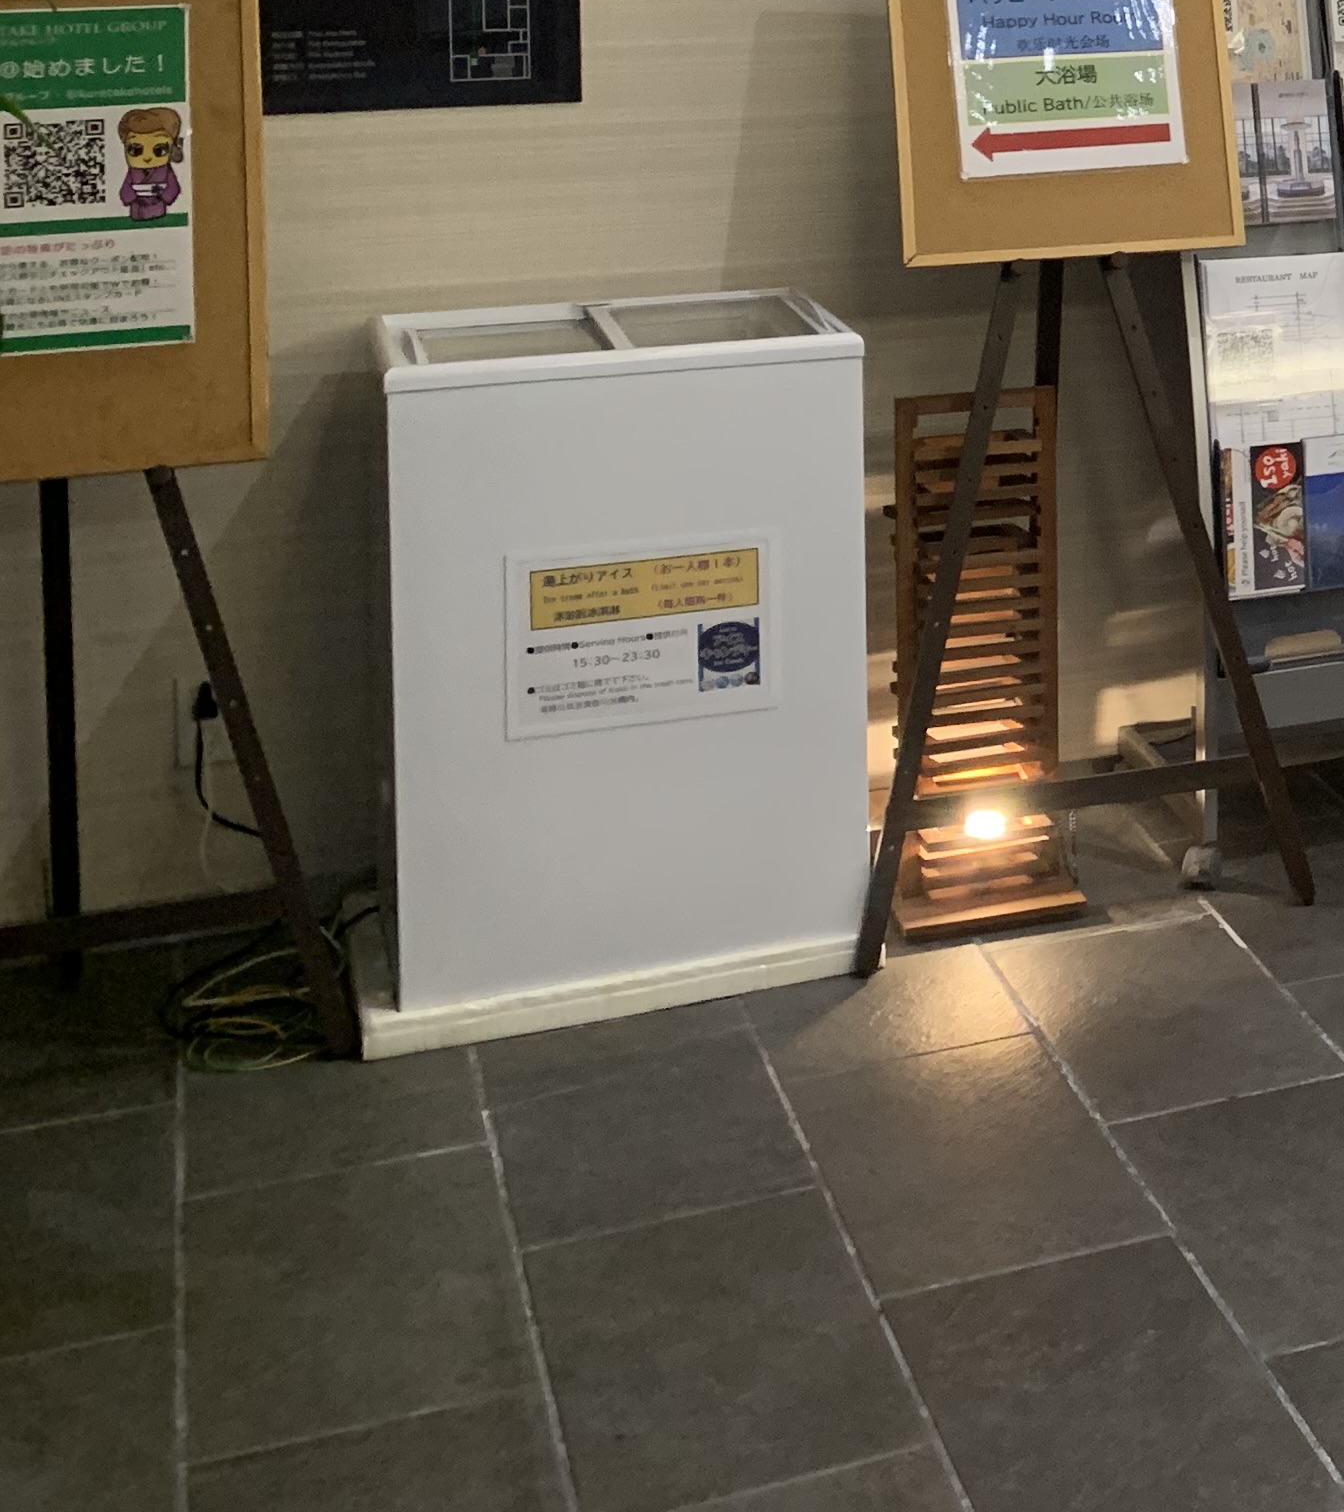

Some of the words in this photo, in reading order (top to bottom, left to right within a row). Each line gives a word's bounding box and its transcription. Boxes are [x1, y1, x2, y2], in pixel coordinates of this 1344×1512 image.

[46, 22, 100, 35] HOTEL
[107, 20, 167, 33] GROUP
[981, 14, 1038, 30] Happy
[1044, 13, 1085, 26] Hour
[1091, 10, 1136, 26] Roo
[1036, 65, 1098, 86] 大浴場
[1235, 272, 1292, 284] RESTAURANT
[1299, 270, 1319, 281] MAP
[1260, 455, 1278, 489] Iso
[1275, 448, 1290, 479] yaki
